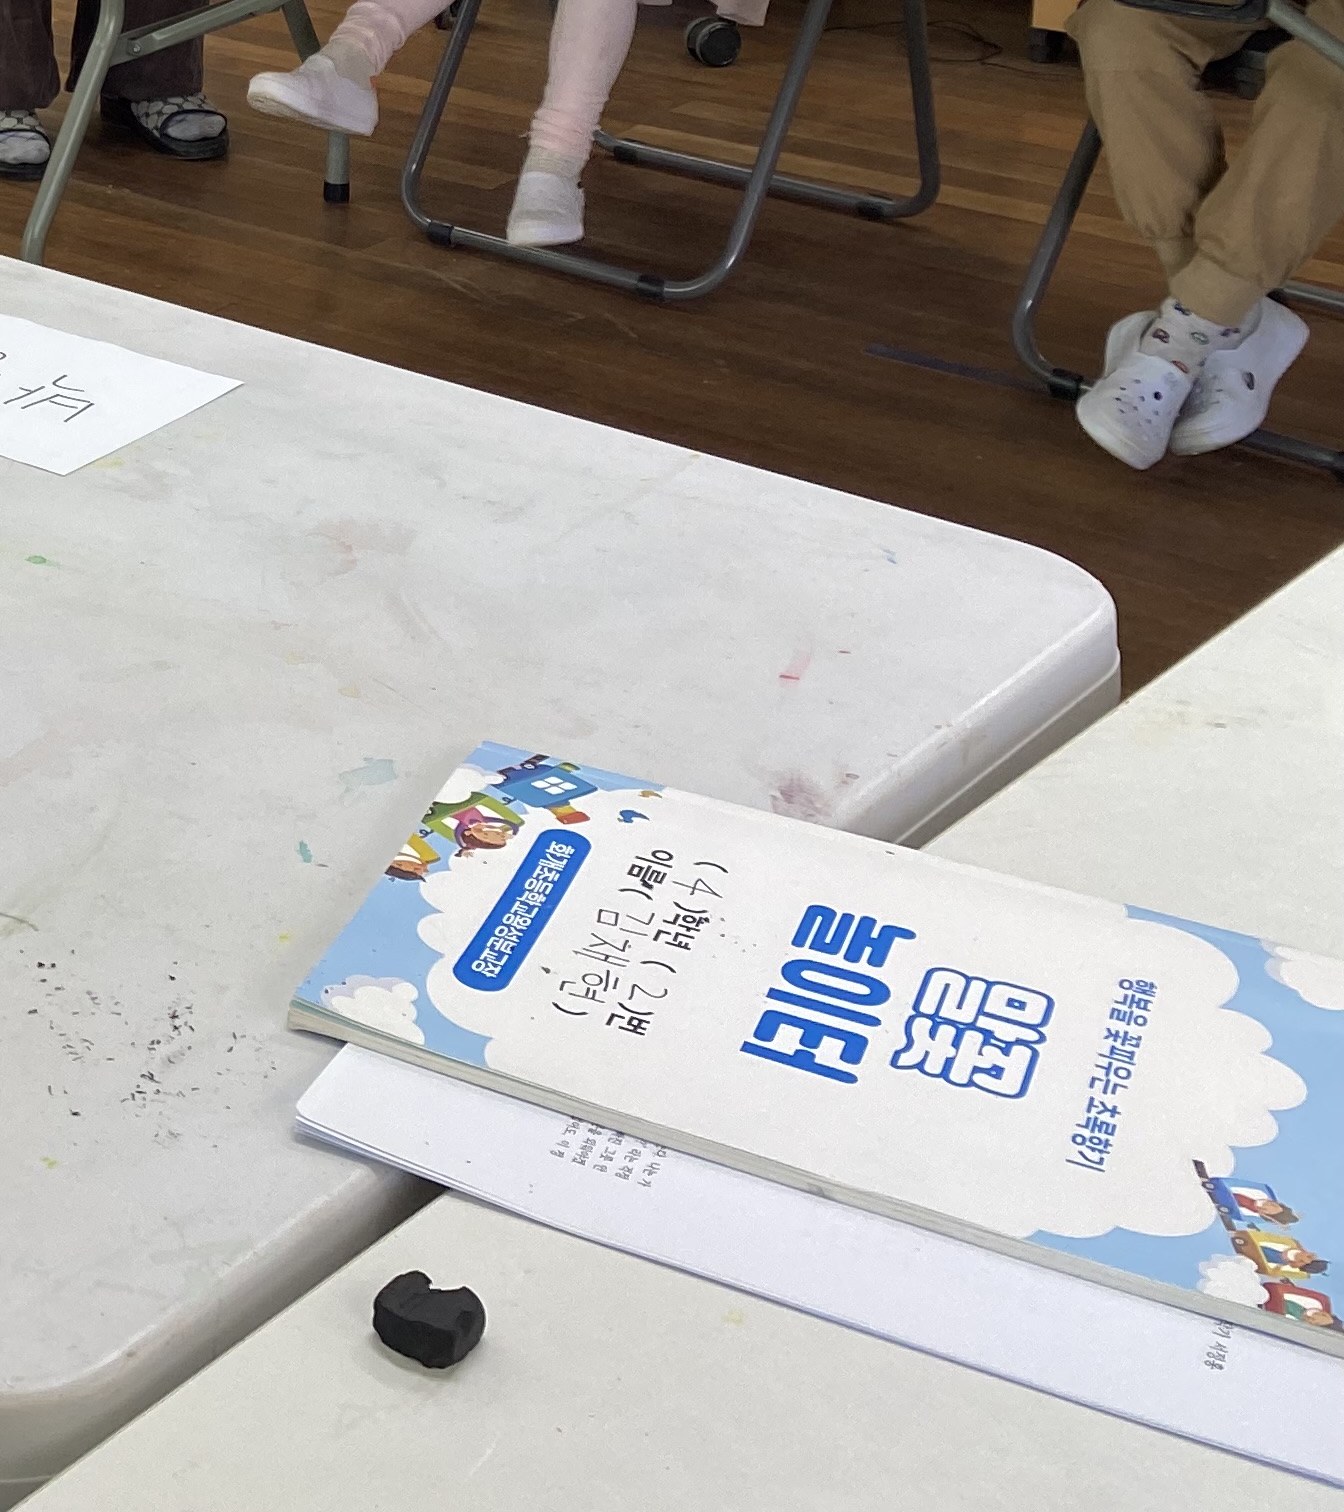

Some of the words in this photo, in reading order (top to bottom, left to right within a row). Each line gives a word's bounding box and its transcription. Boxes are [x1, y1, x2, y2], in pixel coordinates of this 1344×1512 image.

[627, 850, 673, 886] 이름
[472, 841, 575, 978] 화개초등학교왕성분교장
[740, 905, 916, 1084] 놀이터
[1109, 979, 1157, 1026] 행복을
[889, 967, 1055, 1099] 말꽃
[1089, 1028, 1142, 1095] 꽃피우는
[1066, 1096, 1121, 1172] 초록향기
